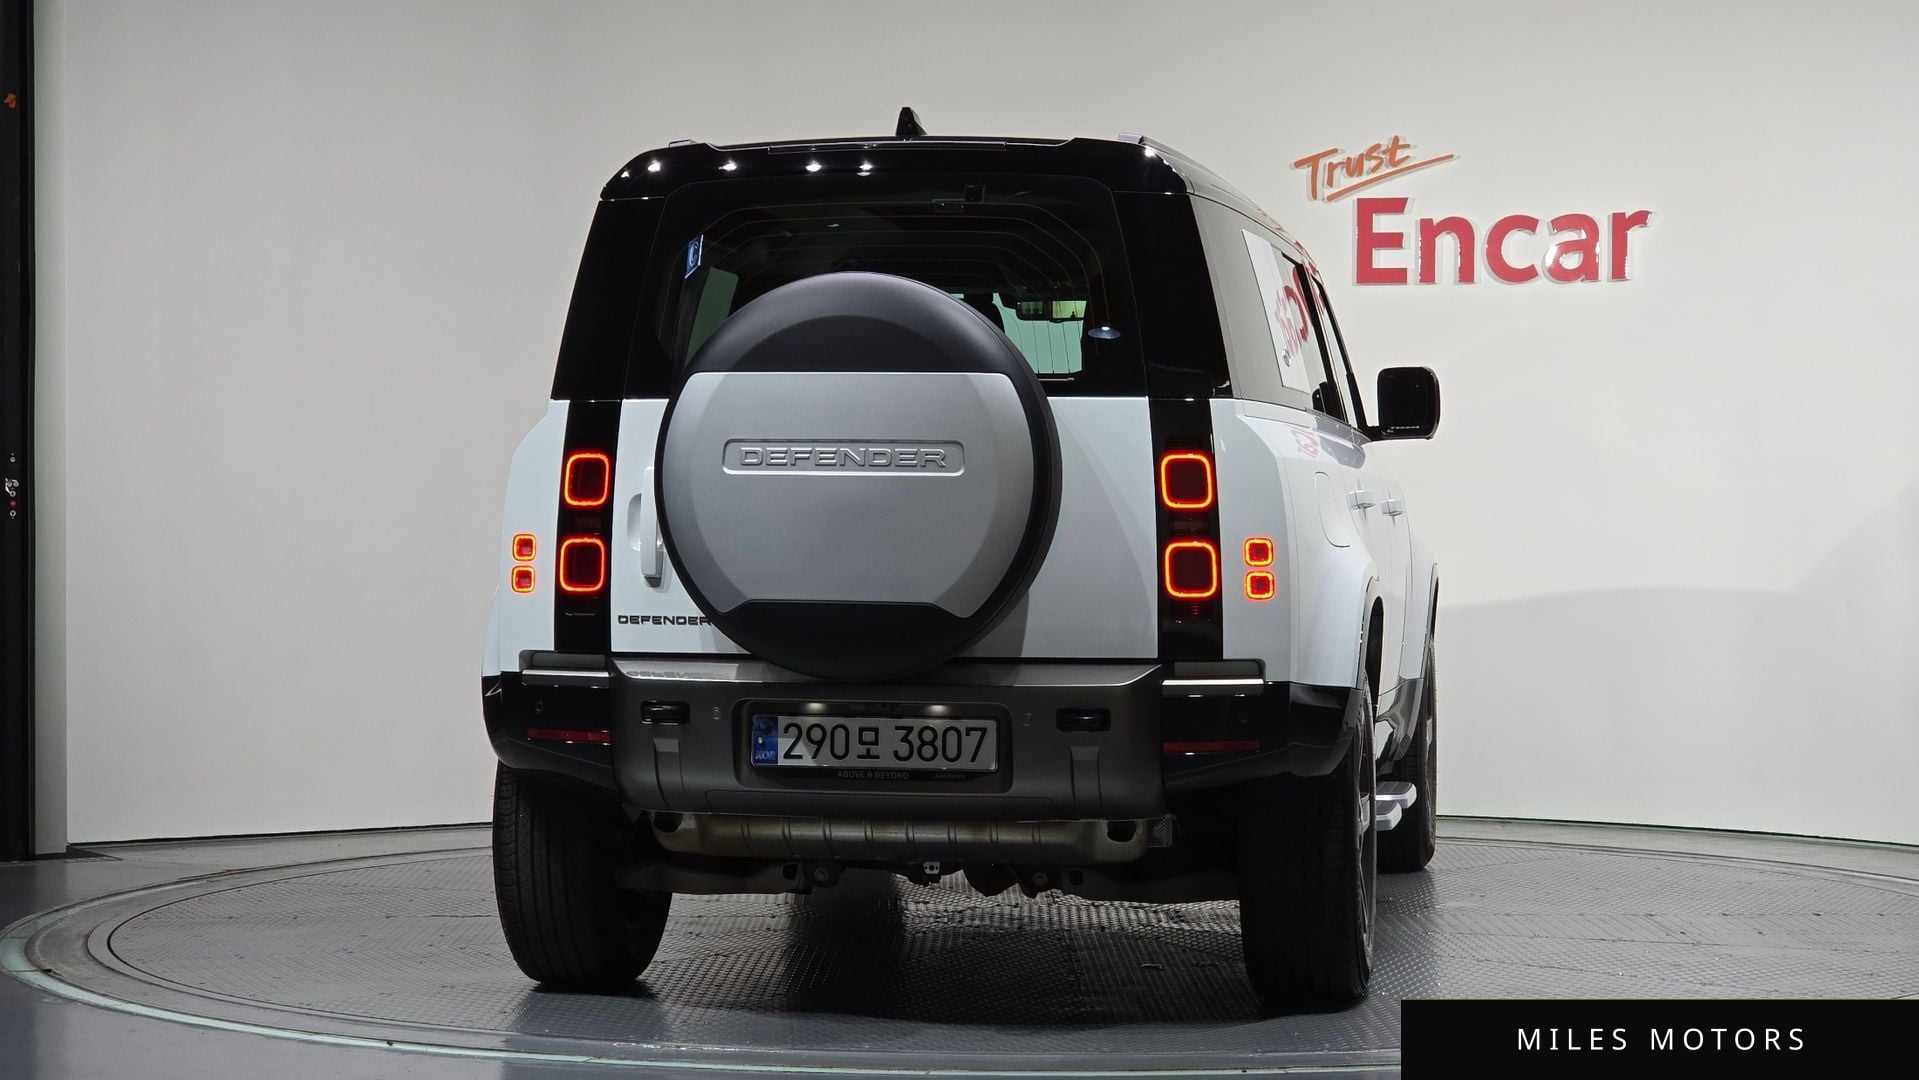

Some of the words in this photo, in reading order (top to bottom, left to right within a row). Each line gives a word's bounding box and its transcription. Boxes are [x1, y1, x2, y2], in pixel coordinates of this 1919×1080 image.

[1294, 135, 1411, 200] Trust
[1355, 197, 1652, 284] Encar
[740, 447, 946, 467] DEFENDER
[617, 615, 711, 625] DEFENDER
[783, 723, 880, 760] 290모
[893, 725, 988, 763] 3807
[837, 770, 865, 778] ABOVE
[875, 771, 909, 780] BEYOND
